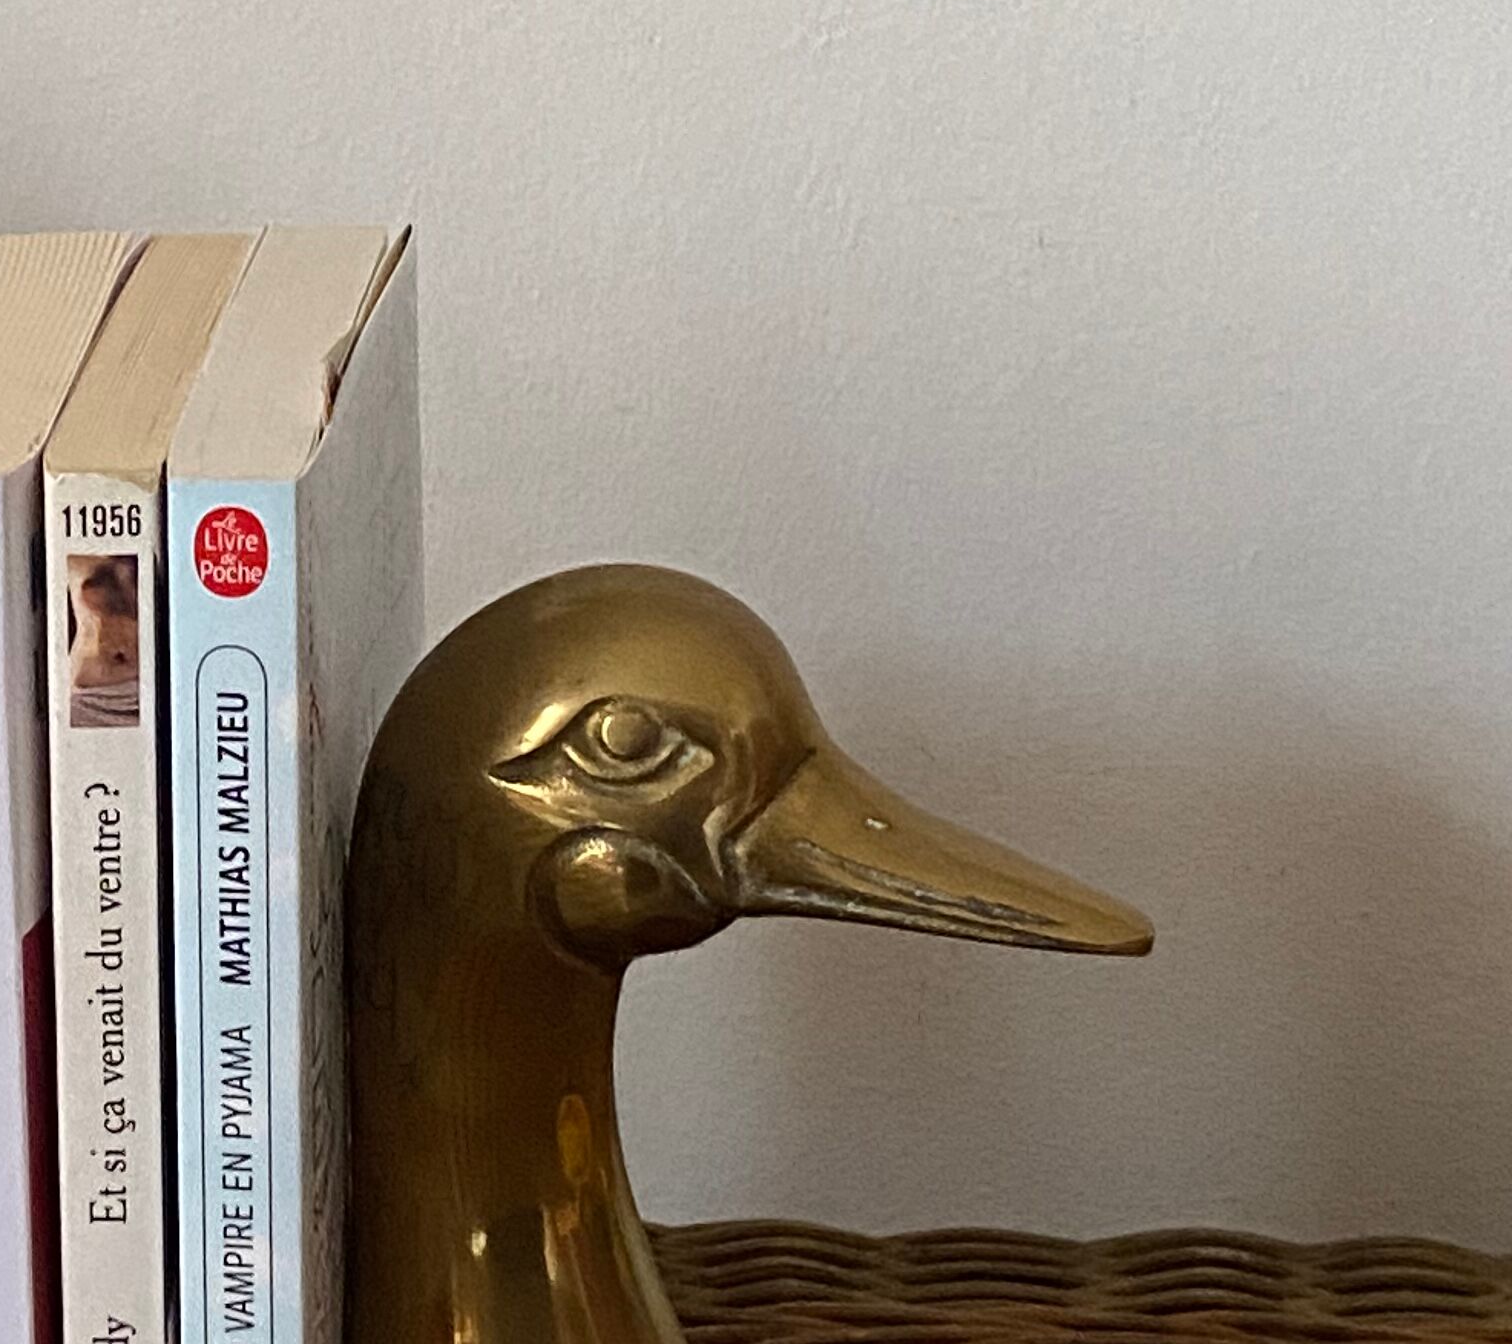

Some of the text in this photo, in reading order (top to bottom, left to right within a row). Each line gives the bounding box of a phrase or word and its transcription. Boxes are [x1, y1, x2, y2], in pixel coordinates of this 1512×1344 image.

[62, 504, 143, 538] 11956
[204, 527, 258, 552] Livre
[199, 559, 263, 584] Poche
[215, 691, 252, 987] MATHIAS MALZIEU
[84, 782, 137, 1225] Et si ça venait du ventre ?
[220, 1024, 254, 1140] PYJAMA
[221, 1151, 254, 1192] EN
[222, 1202, 255, 1334] VAMPIRE
